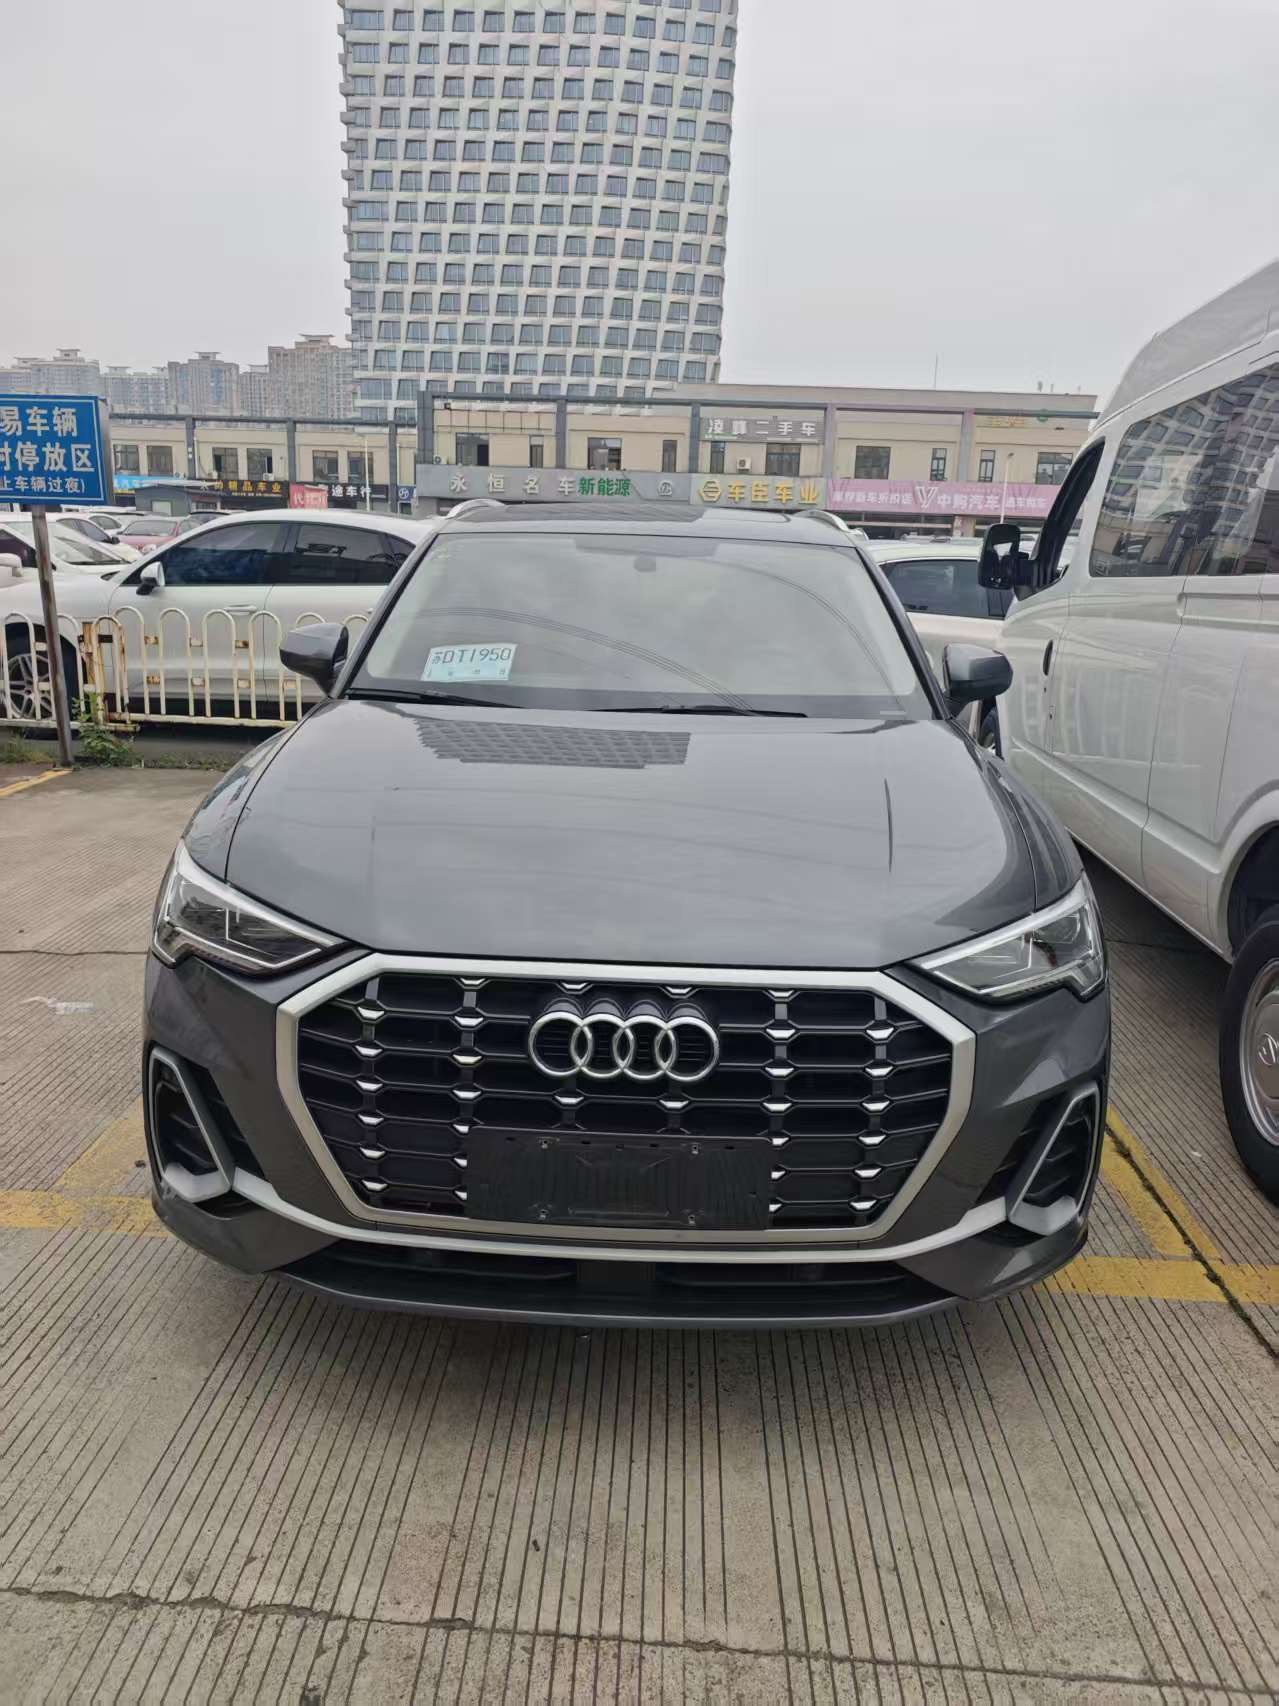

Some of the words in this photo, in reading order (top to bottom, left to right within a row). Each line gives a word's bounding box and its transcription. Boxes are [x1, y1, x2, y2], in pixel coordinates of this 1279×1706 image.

[0, 406, 77, 436] 易车辆
[450, 474, 576, 495] 永恒名车
[578, 477, 632, 497] 新能源
